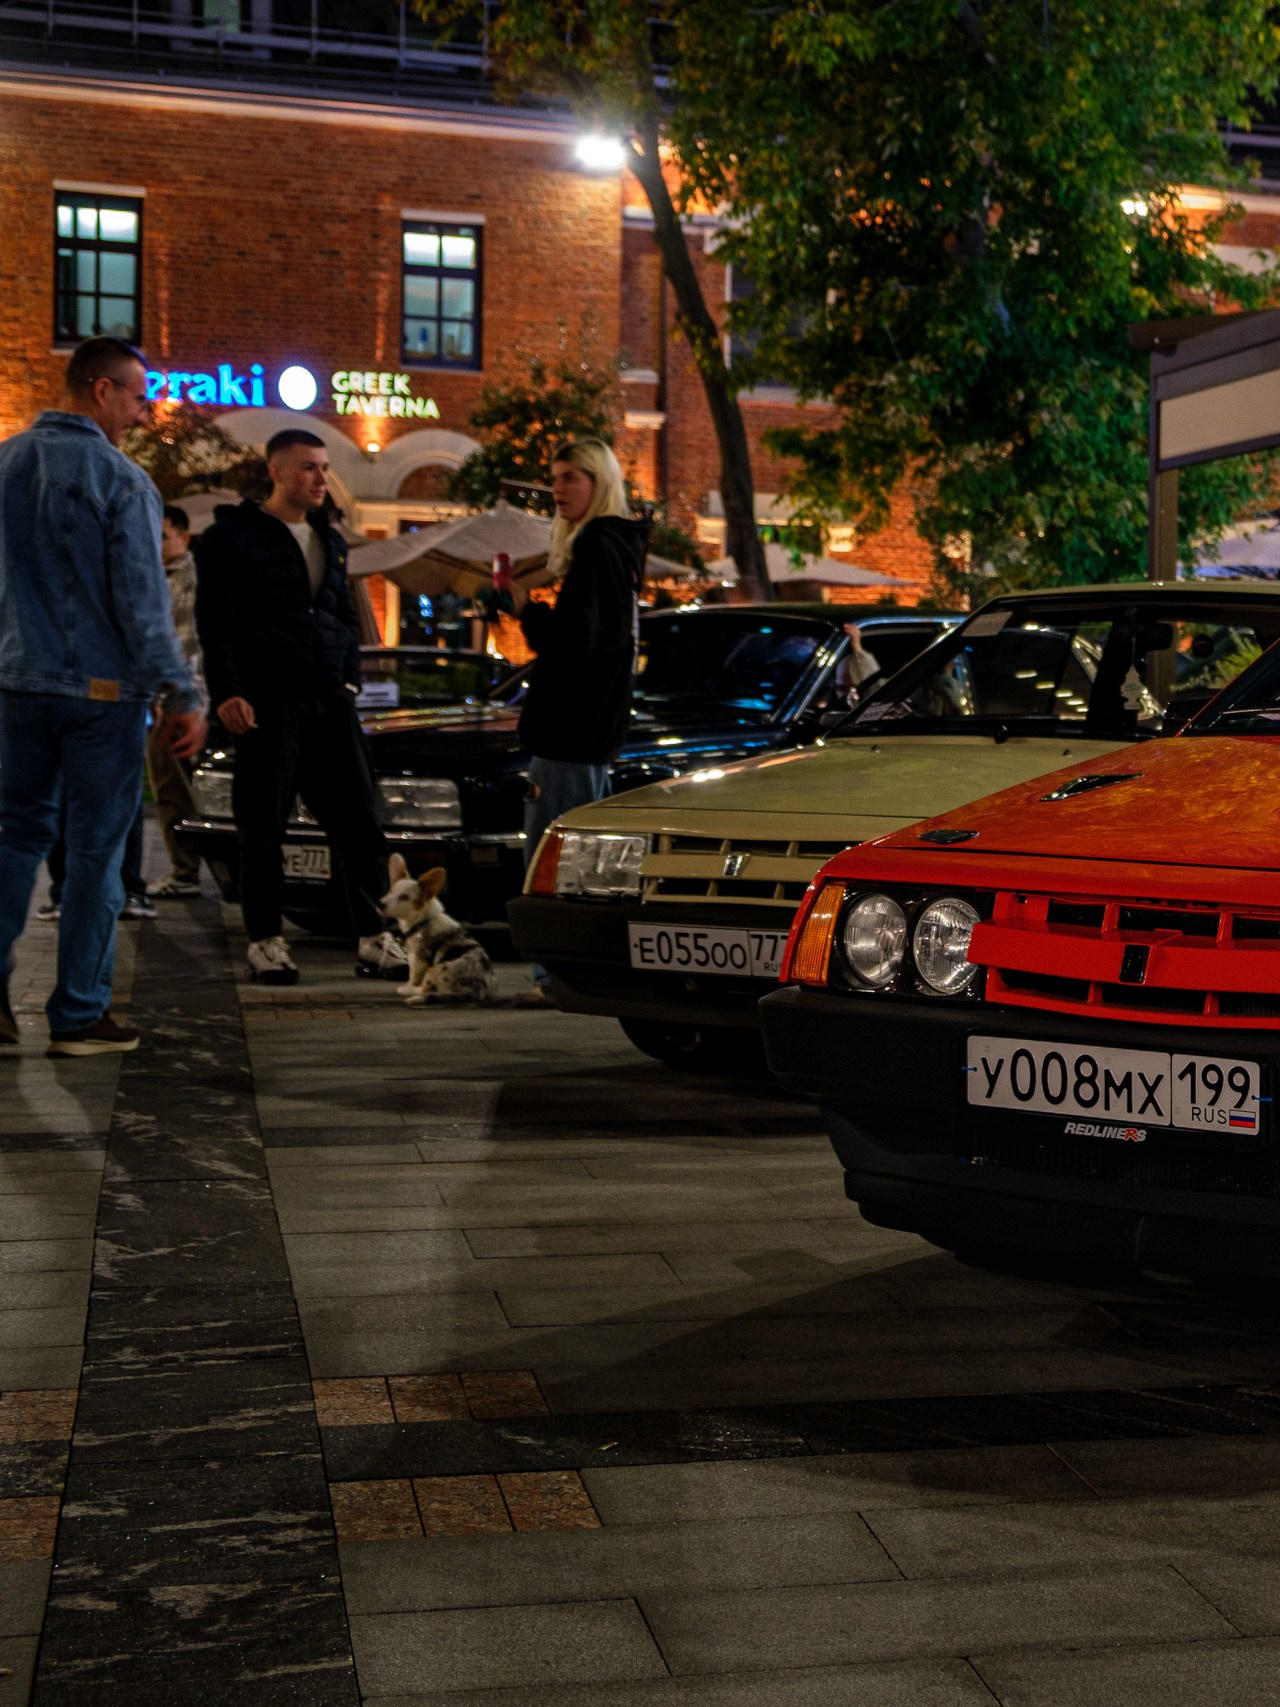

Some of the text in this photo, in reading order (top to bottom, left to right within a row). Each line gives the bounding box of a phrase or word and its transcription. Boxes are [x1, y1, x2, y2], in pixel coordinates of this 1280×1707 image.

[332, 371, 411, 396] GREEK
[332, 393, 440, 420] TAVERNA
[750, 934, 788, 961] 77
[1177, 1062, 1251, 1109] 199
[1191, 1107, 1227, 1125] RUS
